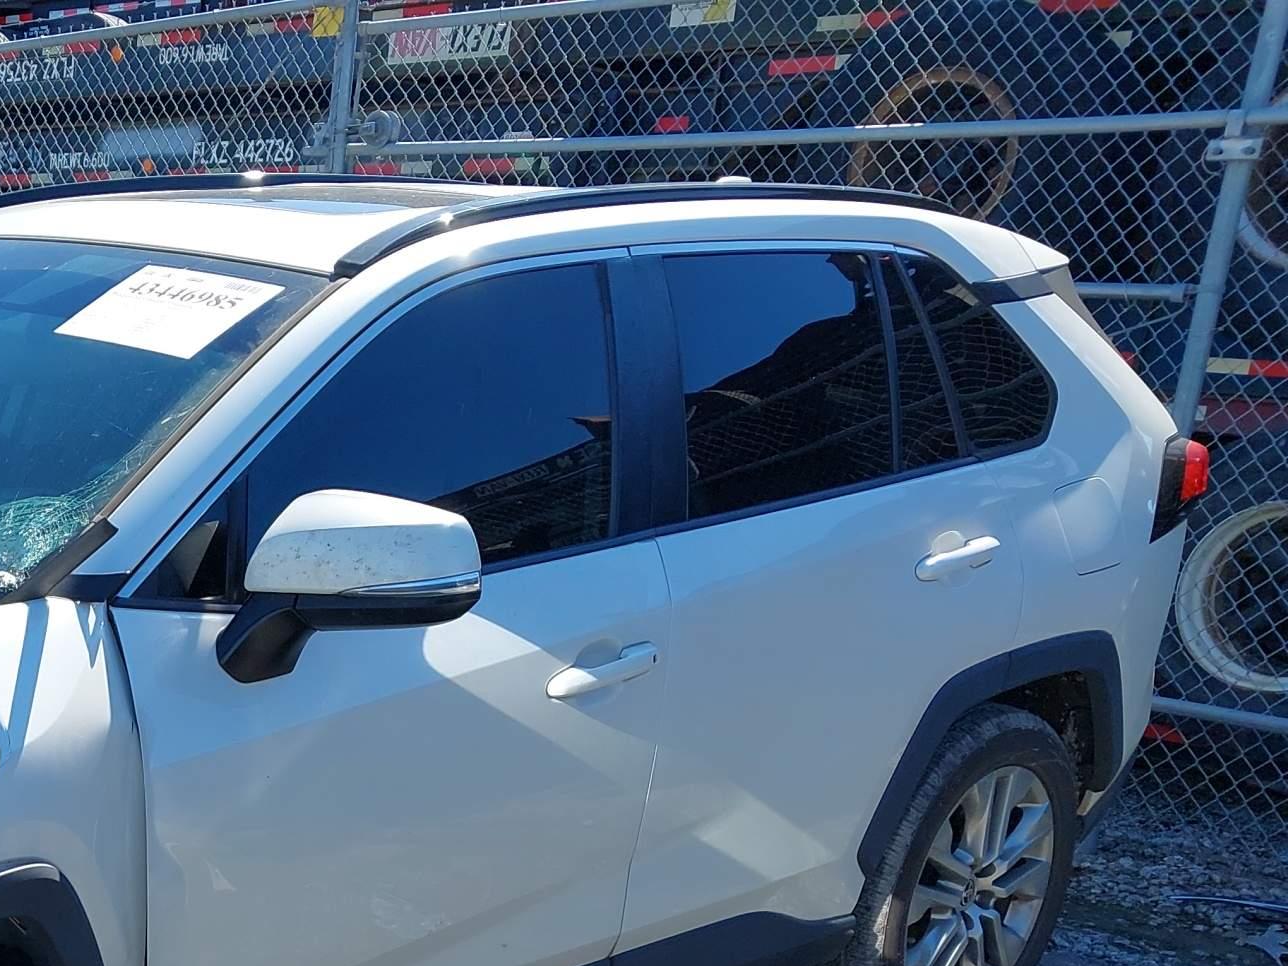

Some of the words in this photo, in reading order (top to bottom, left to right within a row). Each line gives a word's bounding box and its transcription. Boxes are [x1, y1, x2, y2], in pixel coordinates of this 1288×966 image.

[192, 140, 230, 165] FLXZ
[234, 138, 295, 164] 442726
[128, 281, 244, 310] 43446985
